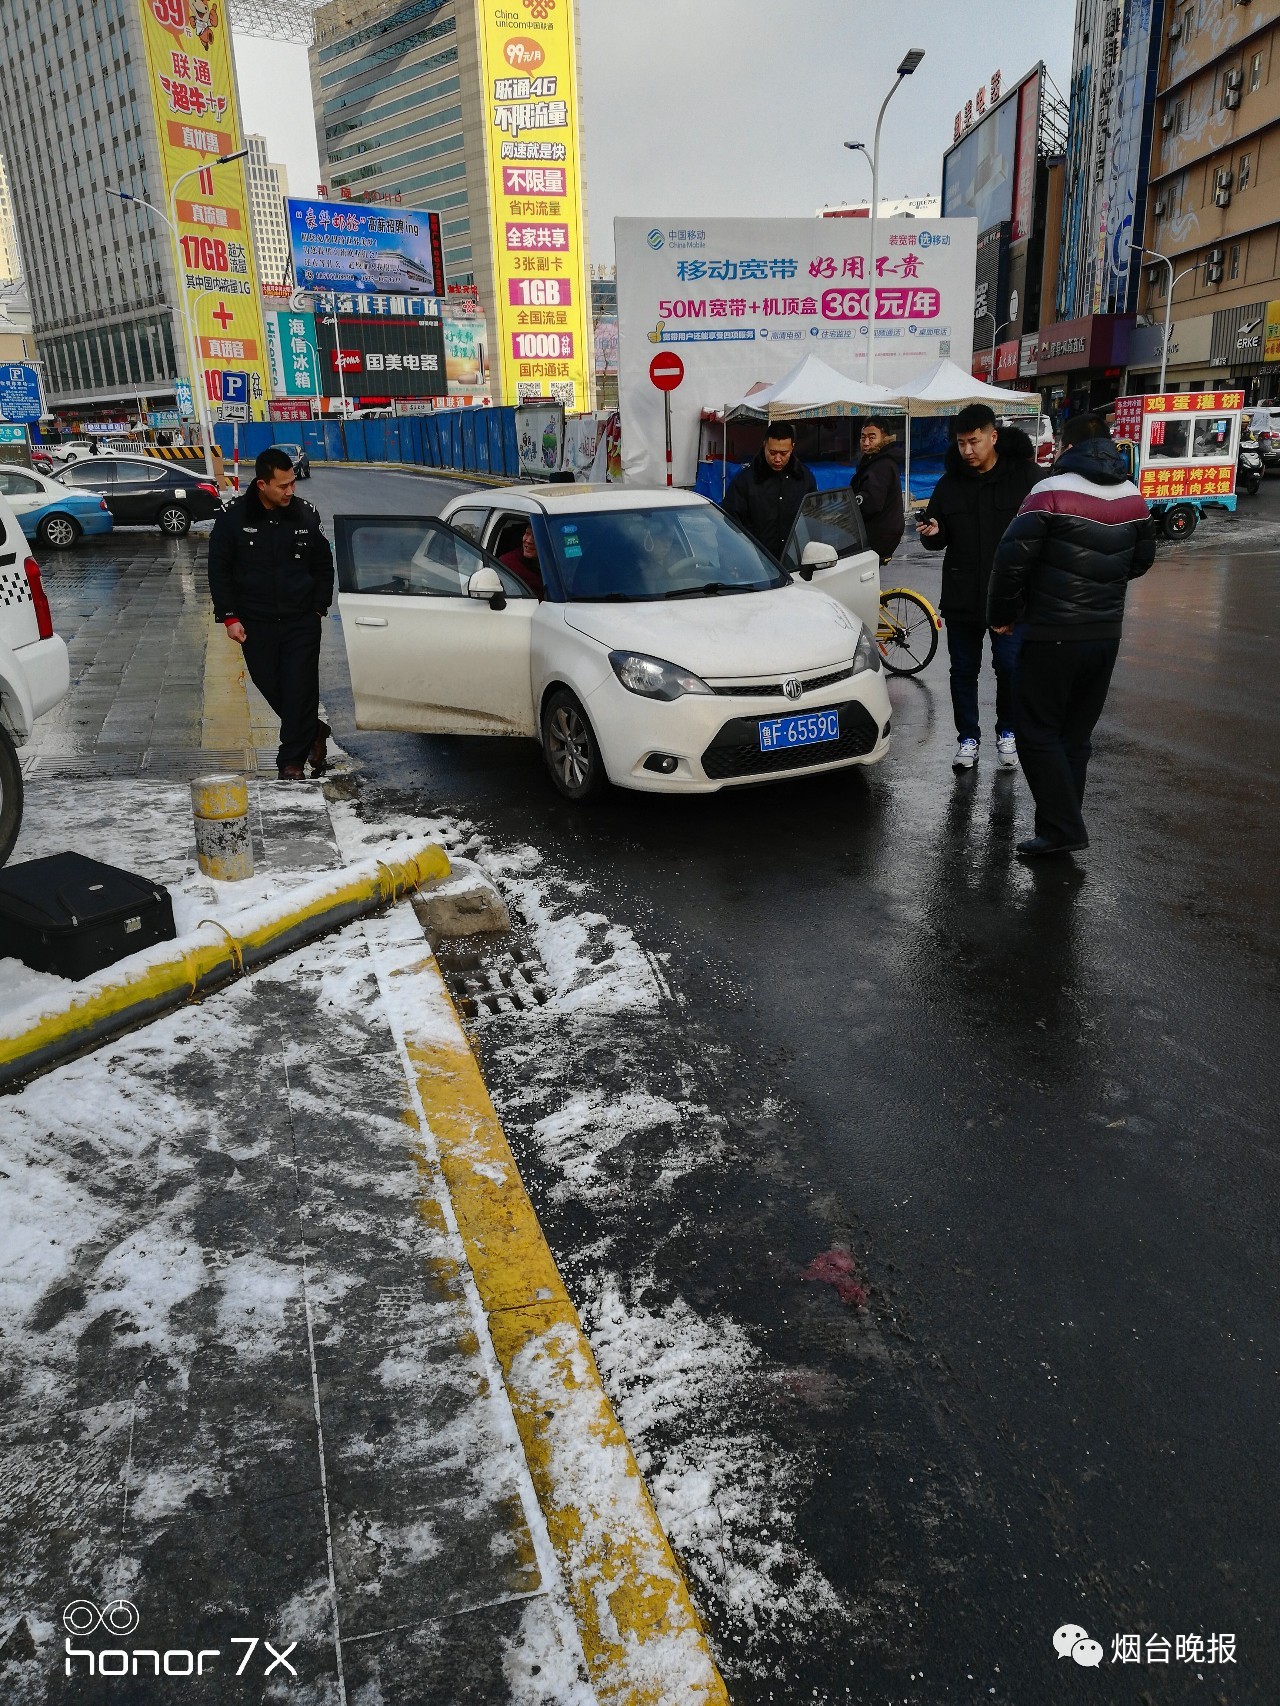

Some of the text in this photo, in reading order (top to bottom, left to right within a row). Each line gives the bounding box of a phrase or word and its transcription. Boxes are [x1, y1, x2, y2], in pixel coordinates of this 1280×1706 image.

[494, 9, 519, 20] China
[171, 51, 213, 86] 联通
[494, 76, 557, 100] 联通4G
[494, 100, 568, 138] 不限流量
[181, 126, 220, 154] 真优惠
[500, 141, 566, 161] 网速就是快
[506, 168, 564, 193] 不限量
[191, 203, 228, 228] 真流量
[509, 200, 562, 217] 省内流量
[506, 227, 566, 248] 全家共享
[668, 229, 706, 241] 中国移动
[668, 241, 706, 249] China Mobile
[889, 231, 951, 248] 装宽带选移动
[180, 235, 246, 273] 17GB 超大
[513, 256, 563, 272] 3张副卡
[228, 257, 248, 275] 流量
[676, 252, 925, 282] 移动宽带 好用不贵
[518, 279, 561, 306] 1GB
[658, 291, 937, 318] 50M宽带+机顶盒 360元/年
[516, 310, 568, 326] 全国流量
[821, 330, 852, 338] 住宅监控
[918, 327, 948, 336] 桌面电话
[1236, 336, 1260, 349] ERKE
[208, 339, 245, 360] 真语音
[266, 321, 279, 387] Hisense
[288, 318, 311, 389] 海信冰箱
[515, 333, 571, 358] 1000 分钟
[365, 353, 439, 371] 国美电器
[519, 362, 570, 378] 国内通话
[226, 376, 243, 397] P
[250, 372, 264, 400] 分钟
[176, 386, 193, 415] 快修
[1147, 393, 1241, 412] 鸡蛋灌饼
[1143, 466, 1232, 483] 里脊饼 烤冷面
[1142, 480, 1231, 498] 手抓饼 肉夹馍
[785, 679, 801, 698] MG
